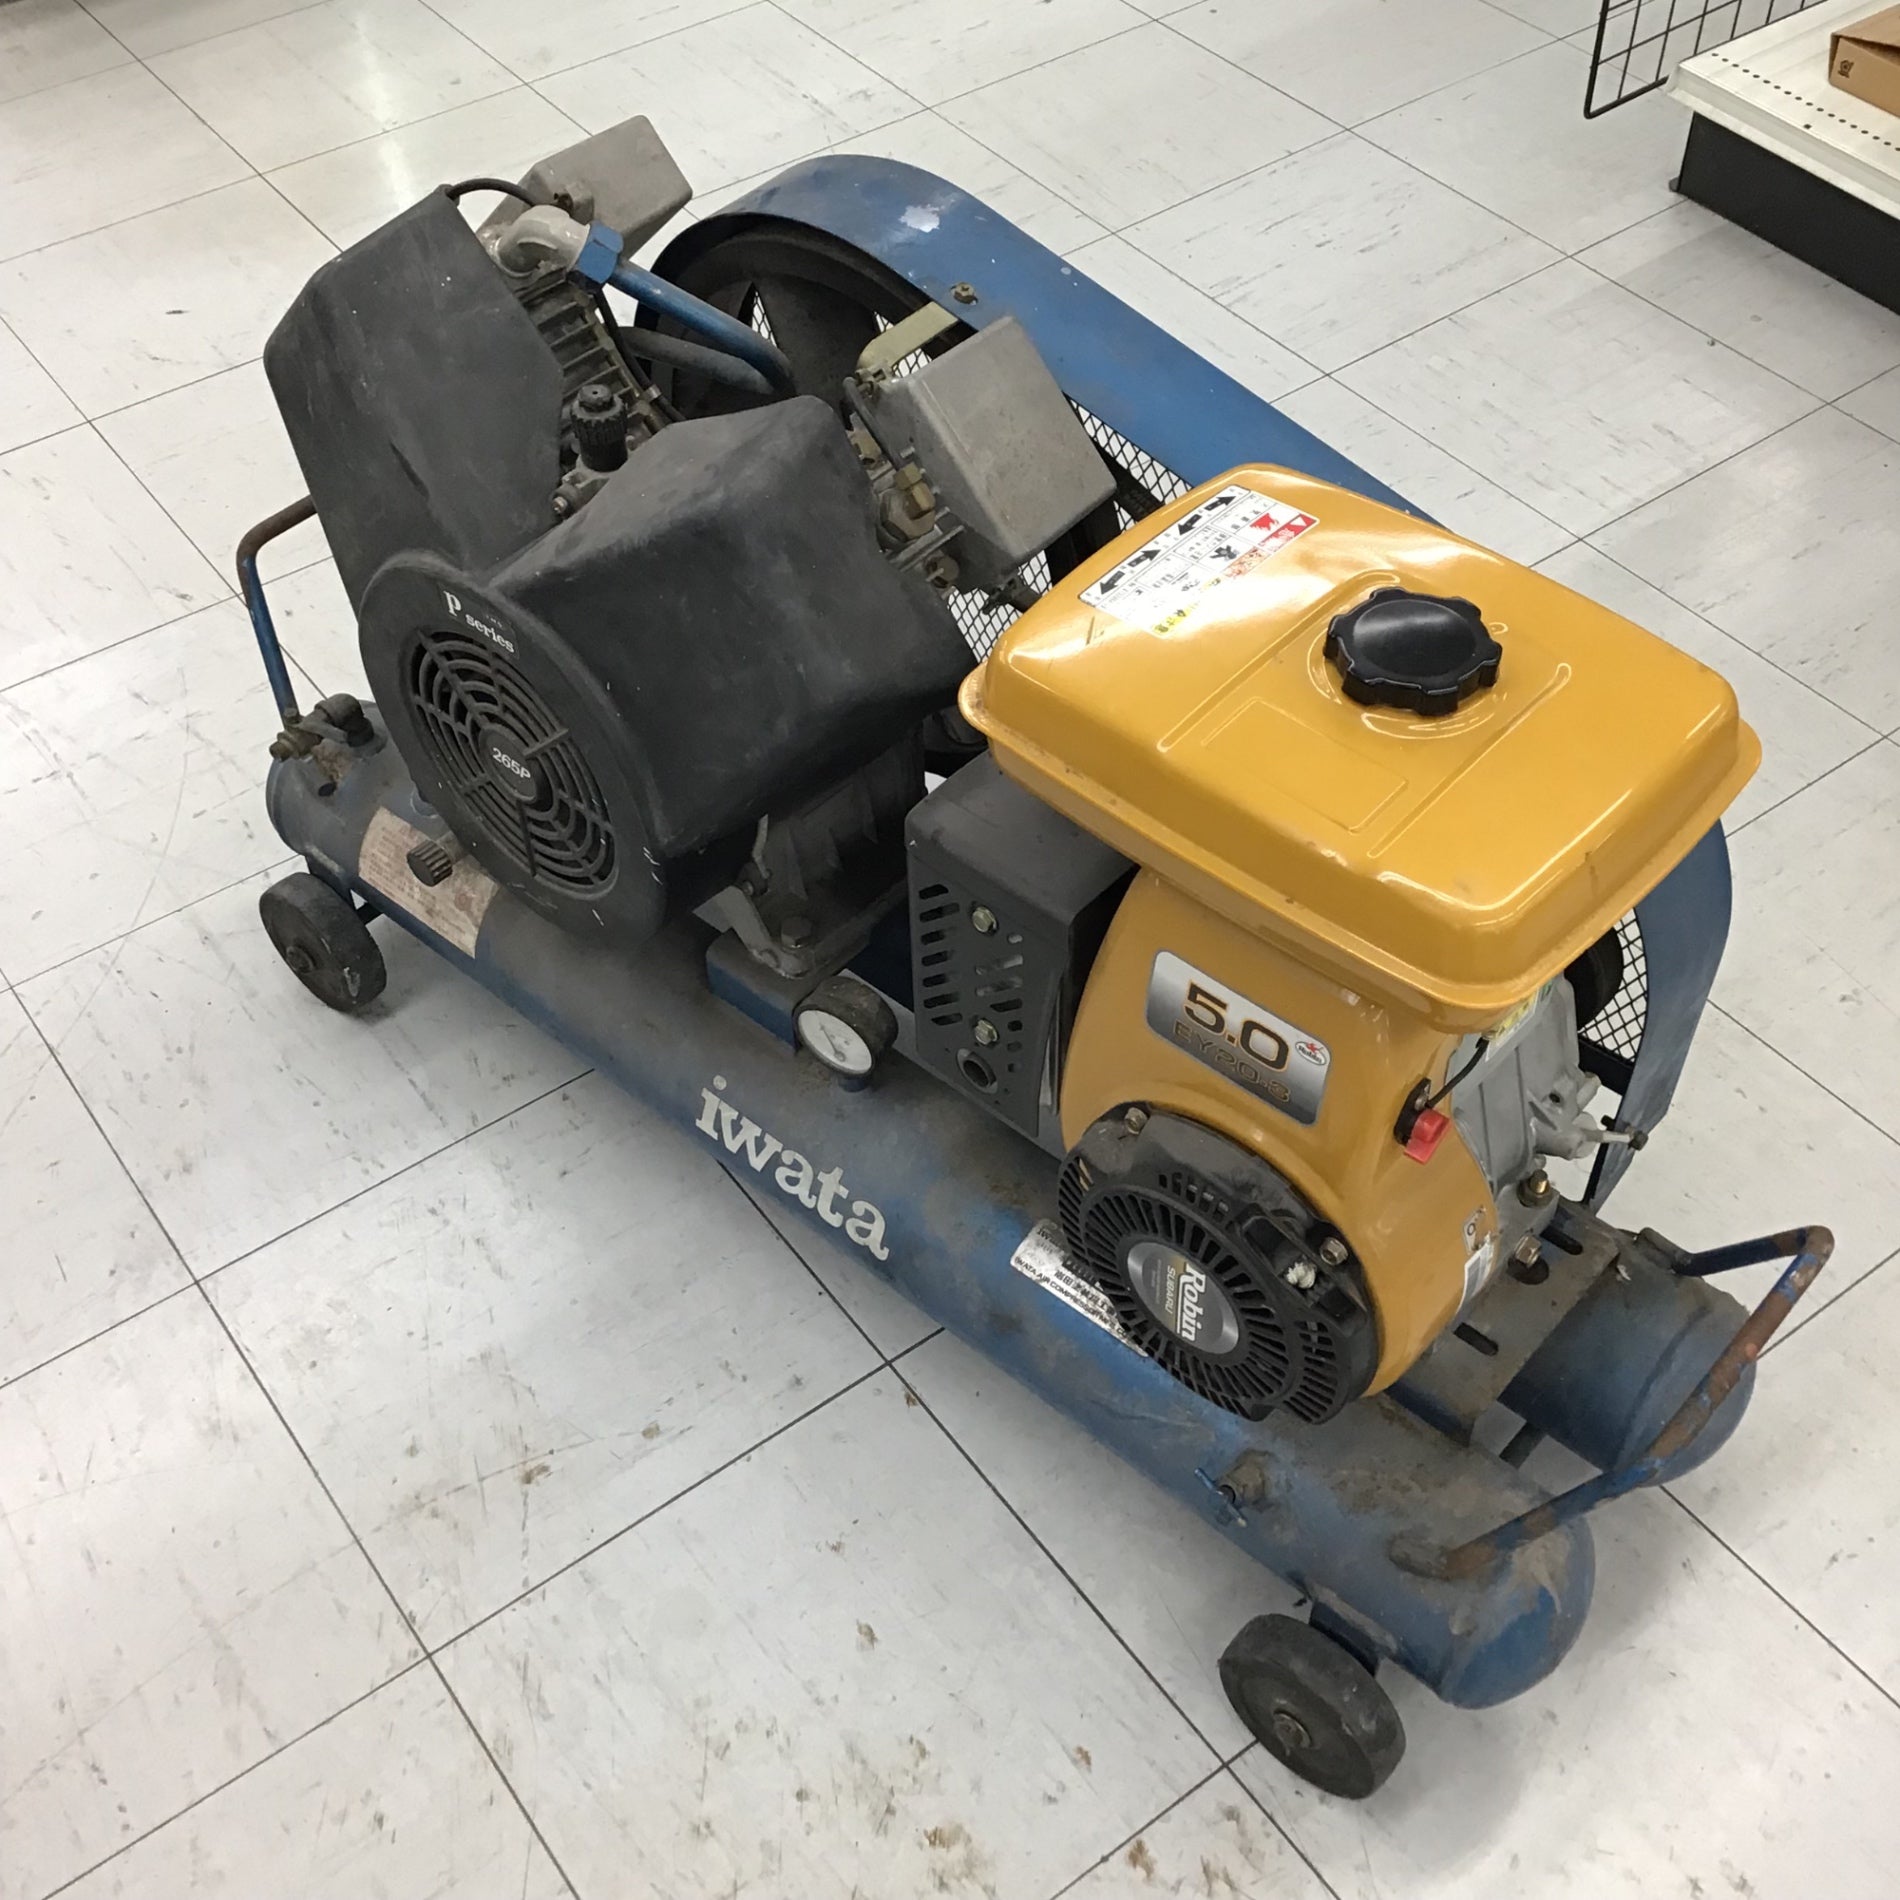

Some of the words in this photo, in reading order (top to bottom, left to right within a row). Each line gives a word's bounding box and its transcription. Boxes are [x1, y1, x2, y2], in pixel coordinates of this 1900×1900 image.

[465, 613, 515, 653] series
[492, 747, 531, 778] 265P
[1184, 979, 1290, 1072] 5.0
[695, 1075, 890, 1262] iwata
[1165, 1265, 1176, 1314] SUBARU
[1182, 1262, 1207, 1342] Robin
